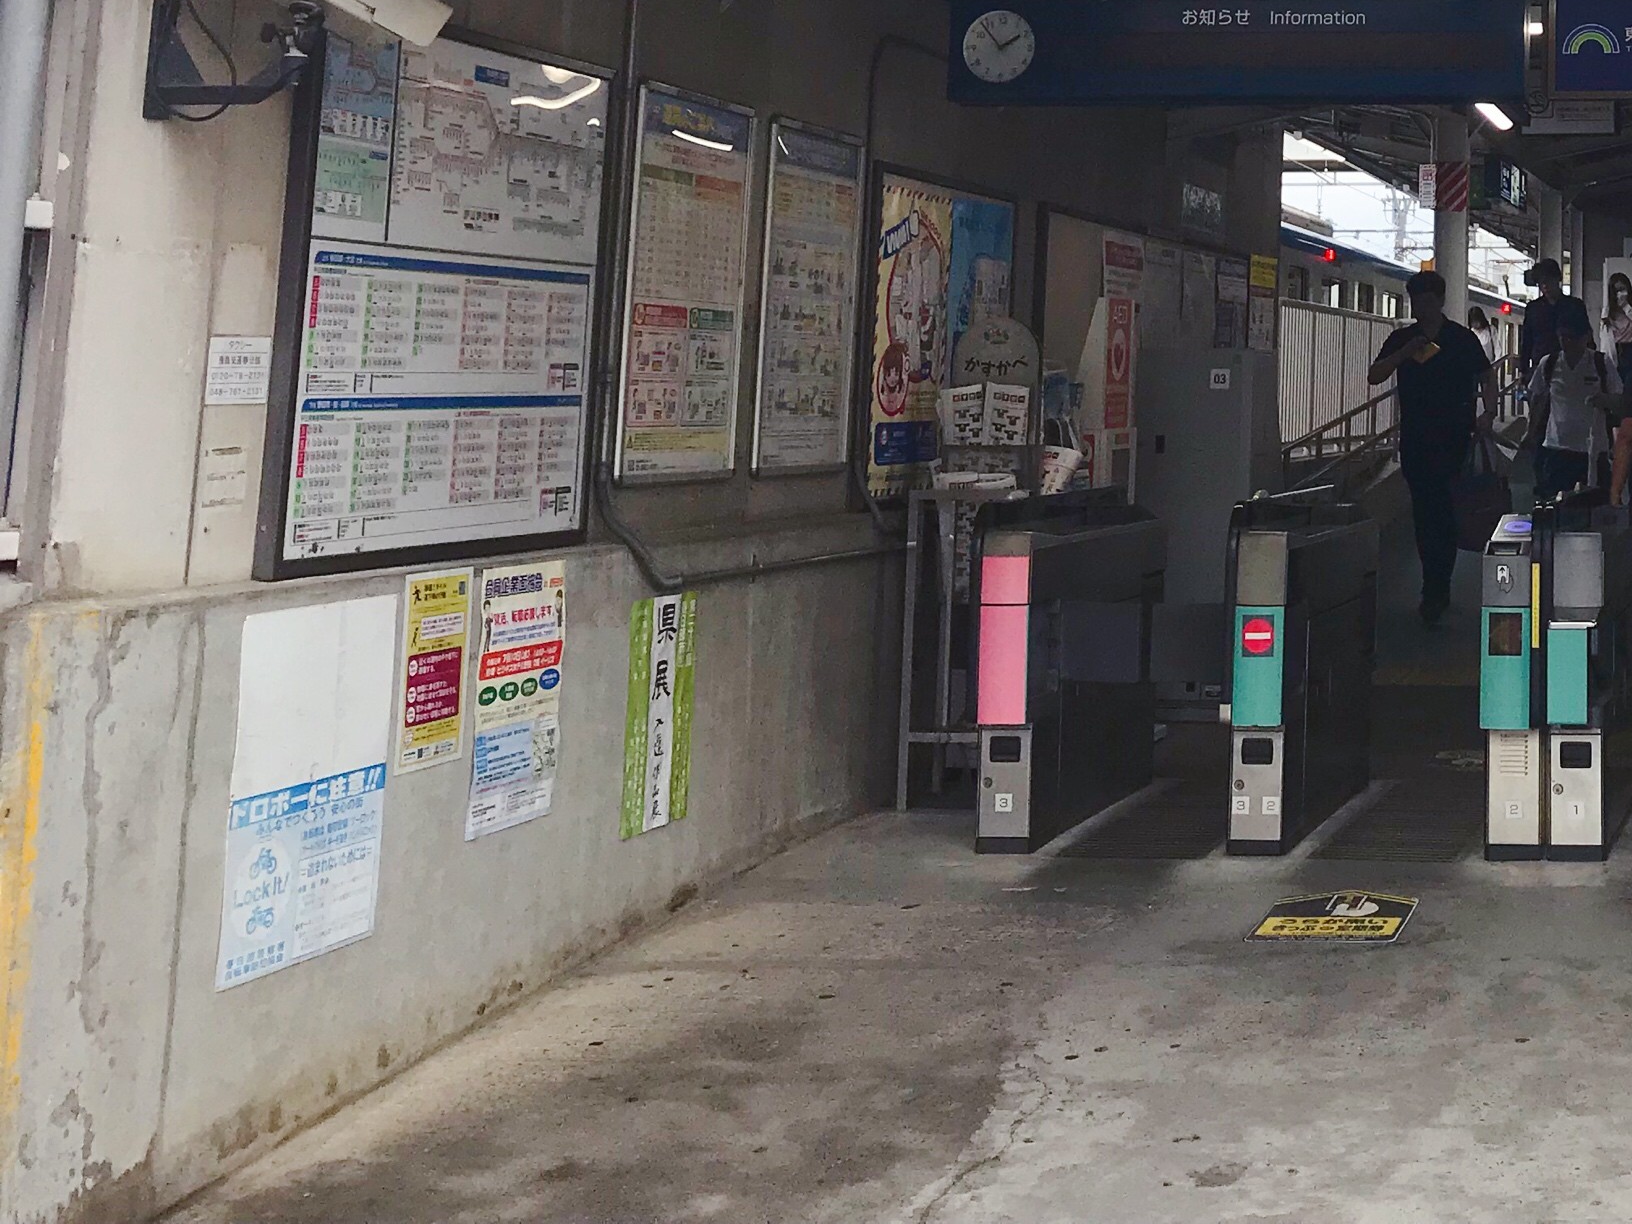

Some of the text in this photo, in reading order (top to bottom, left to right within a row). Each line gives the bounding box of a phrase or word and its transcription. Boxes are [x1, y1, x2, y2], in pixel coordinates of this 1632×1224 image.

[1182, 9, 1366, 27] お知らせ Information
[1212, 373, 1227, 385] 03
[999, 797, 1008, 808] 3
[1236, 800, 1245, 811] 3
[1266, 800, 1275, 811] 2
[1510, 804, 1519, 815] 2
[1573, 804, 1580, 815] 1
